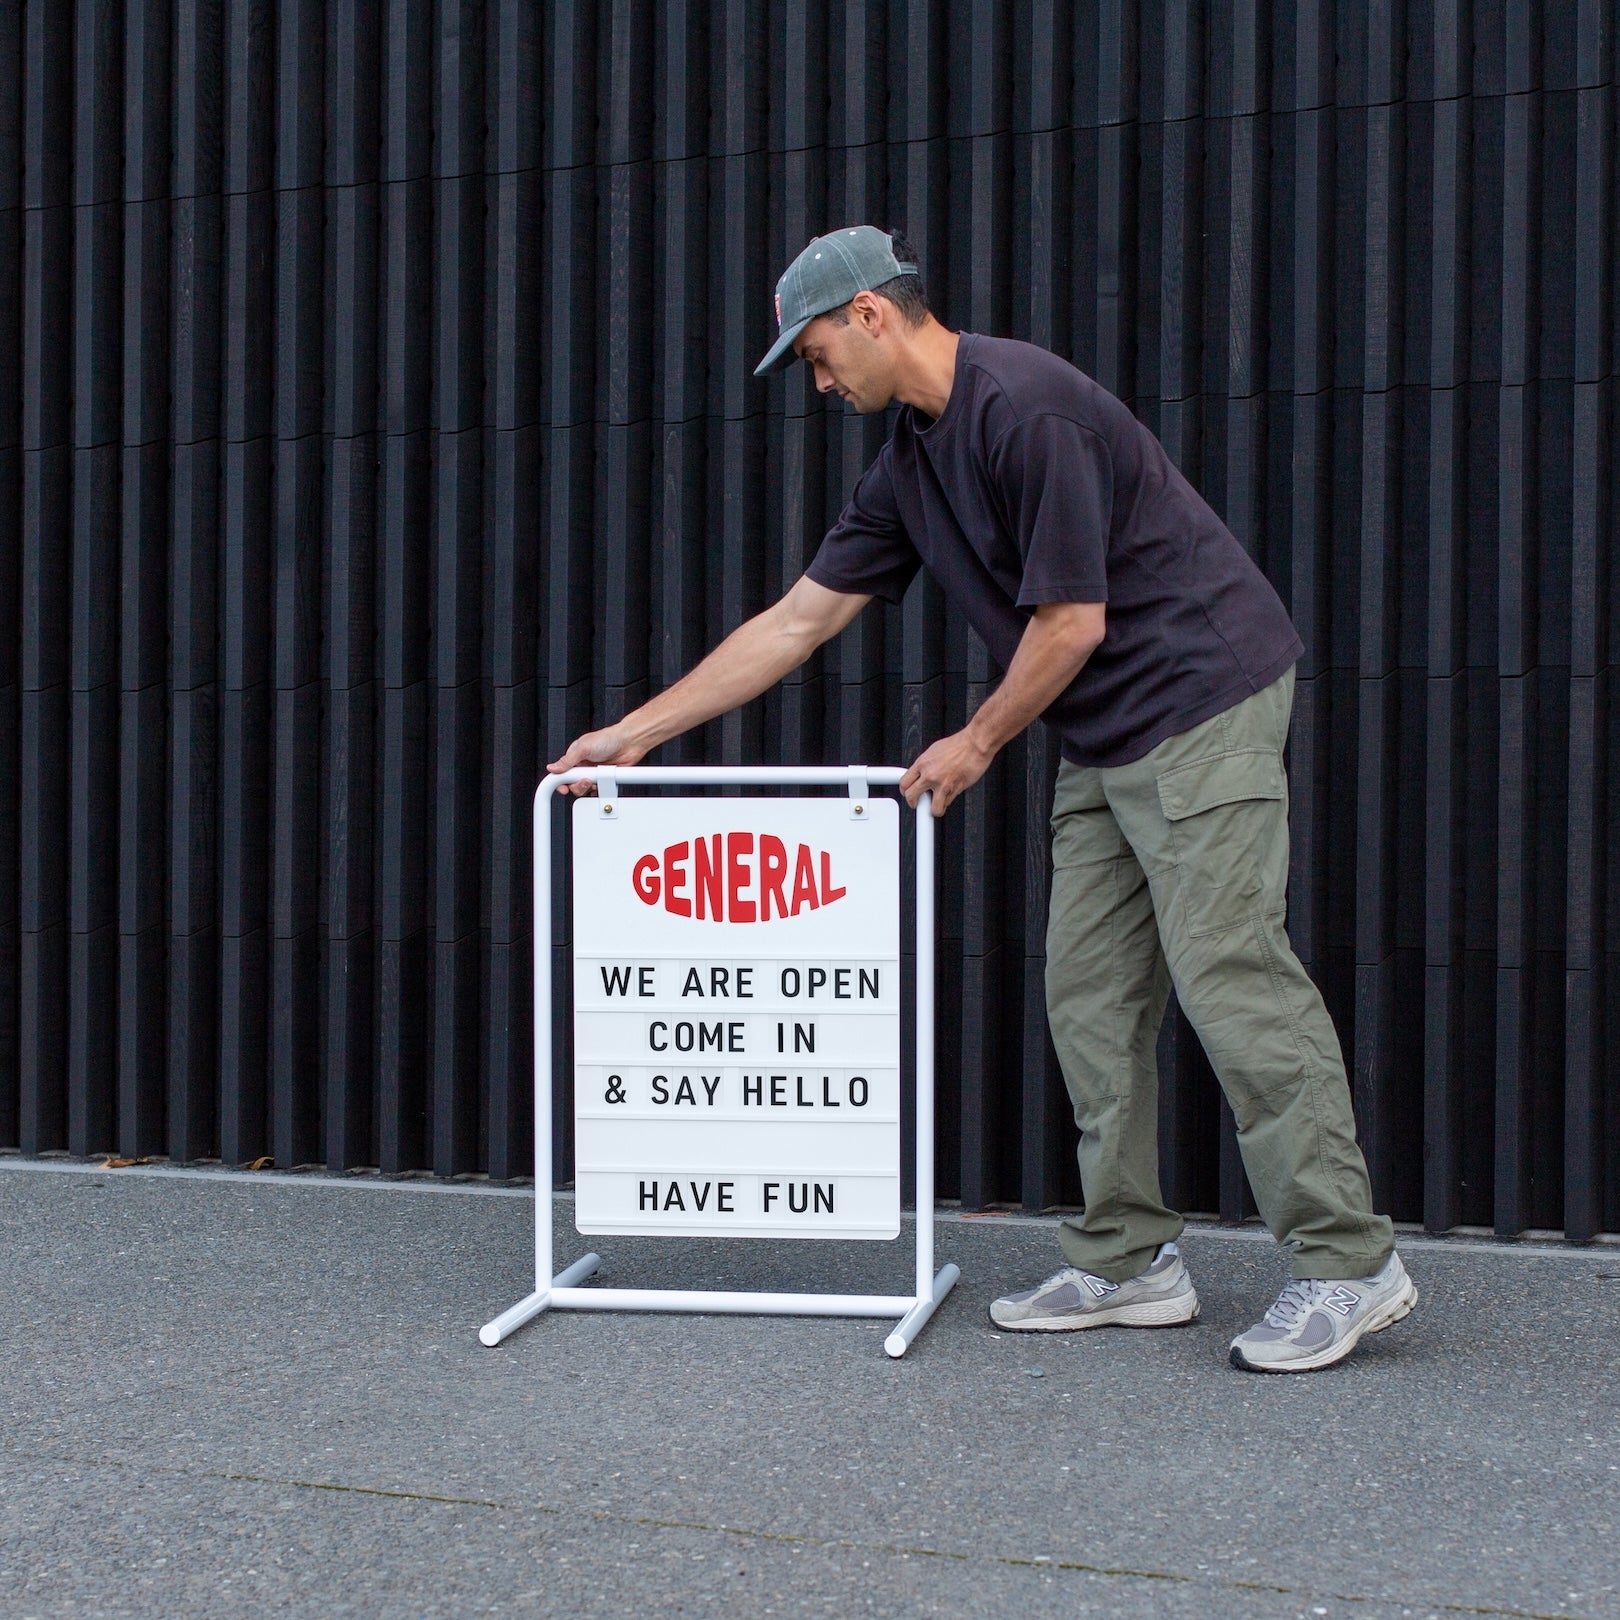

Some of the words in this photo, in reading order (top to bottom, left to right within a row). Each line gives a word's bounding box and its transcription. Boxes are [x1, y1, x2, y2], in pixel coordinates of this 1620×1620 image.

[632, 831, 847, 924] GENERAL
[600, 966, 656, 997] WE
[681, 967, 754, 998] ARE
[780, 967, 879, 999] OPEN
[649, 1021, 745, 1053] COME
[777, 1022, 815, 1053] IN
[604, 1074, 627, 1105] &
[651, 1075, 721, 1107] SAY
[743, 1075, 869, 1107] HELLO
[639, 1180, 735, 1213] HAVE
[763, 1182, 834, 1214] FUN
[1082, 1274, 1120, 1297] N
[1324, 1286, 1361, 1316] N
